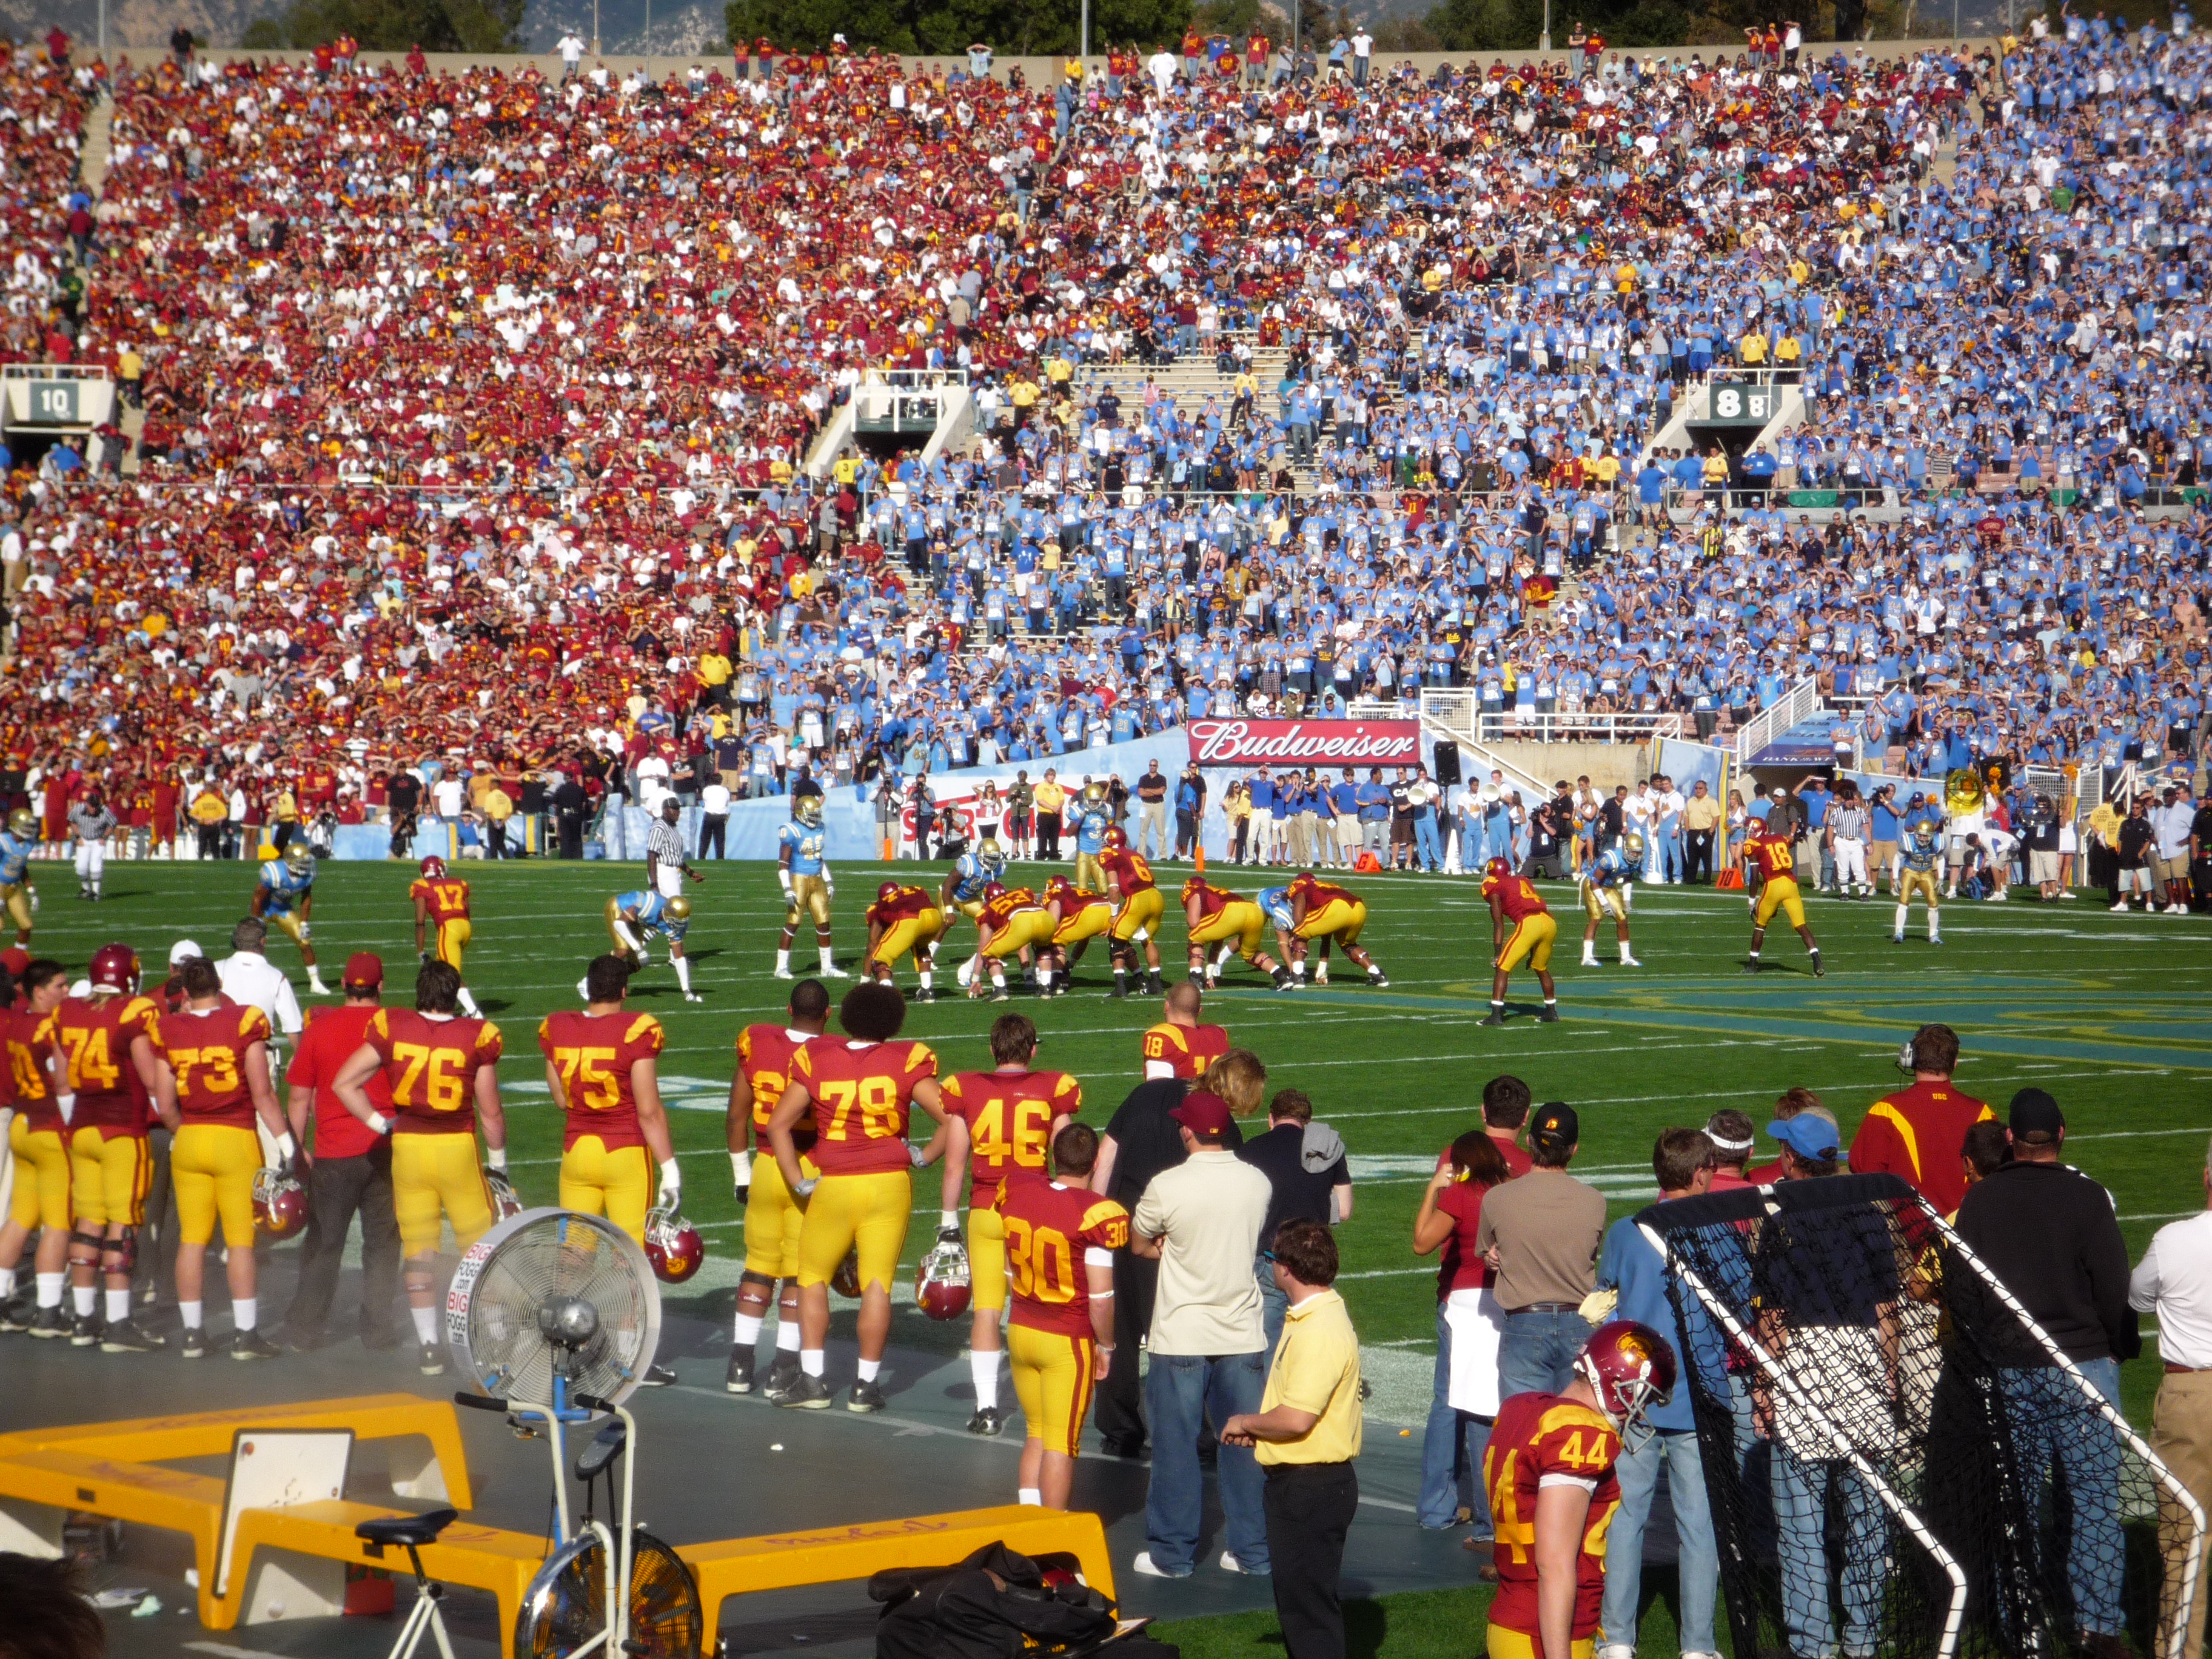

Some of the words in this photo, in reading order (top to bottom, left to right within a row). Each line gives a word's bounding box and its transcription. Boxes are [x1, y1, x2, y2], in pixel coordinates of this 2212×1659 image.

[41, 389, 69, 413] 10
[1717, 389, 1741, 417] 8
[1749, 397, 1764, 417] 8
[843, 463, 849, 472] 3
[1564, 464, 1573, 475] 11
[1409, 502, 1416, 513] 11
[1107, 551, 1122, 563] 63
[1117, 719, 1128, 732] 21
[1190, 722, 1415, 760] Budweiser
[1088, 817, 1102, 839] 3
[1099, 853, 1105, 864] 6
[1355, 854, 1370, 870] G
[1766, 842, 1793, 871] 18
[1130, 856, 1153, 882] 6
[1719, 870, 1735, 886] 10
[434, 885, 464, 911] 17
[990, 887, 1031, 915] 53
[1519, 880, 1541, 903] 4
[62, 1026, 119, 1089] 74
[1144, 1035, 1164, 1058] 18
[167, 1045, 239, 1096] 73
[392, 1041, 466, 1111] 76
[554, 1047, 620, 1110] 75
[819, 1075, 901, 1141] 78
[971, 1098, 1051, 1167] 46
[1105, 1220, 1128, 1248] 30
[465, 1244, 493, 1261] BIG
[1003, 1215, 1076, 1303] 30
[456, 1261, 481, 1278] FOGG
[455, 1278, 471, 1291] .com
[447, 1291, 469, 1313] BIG
[447, 1312, 466, 1332] FOGG
[452, 1333, 465, 1346] .com
[1558, 1430, 1608, 1470] 44
